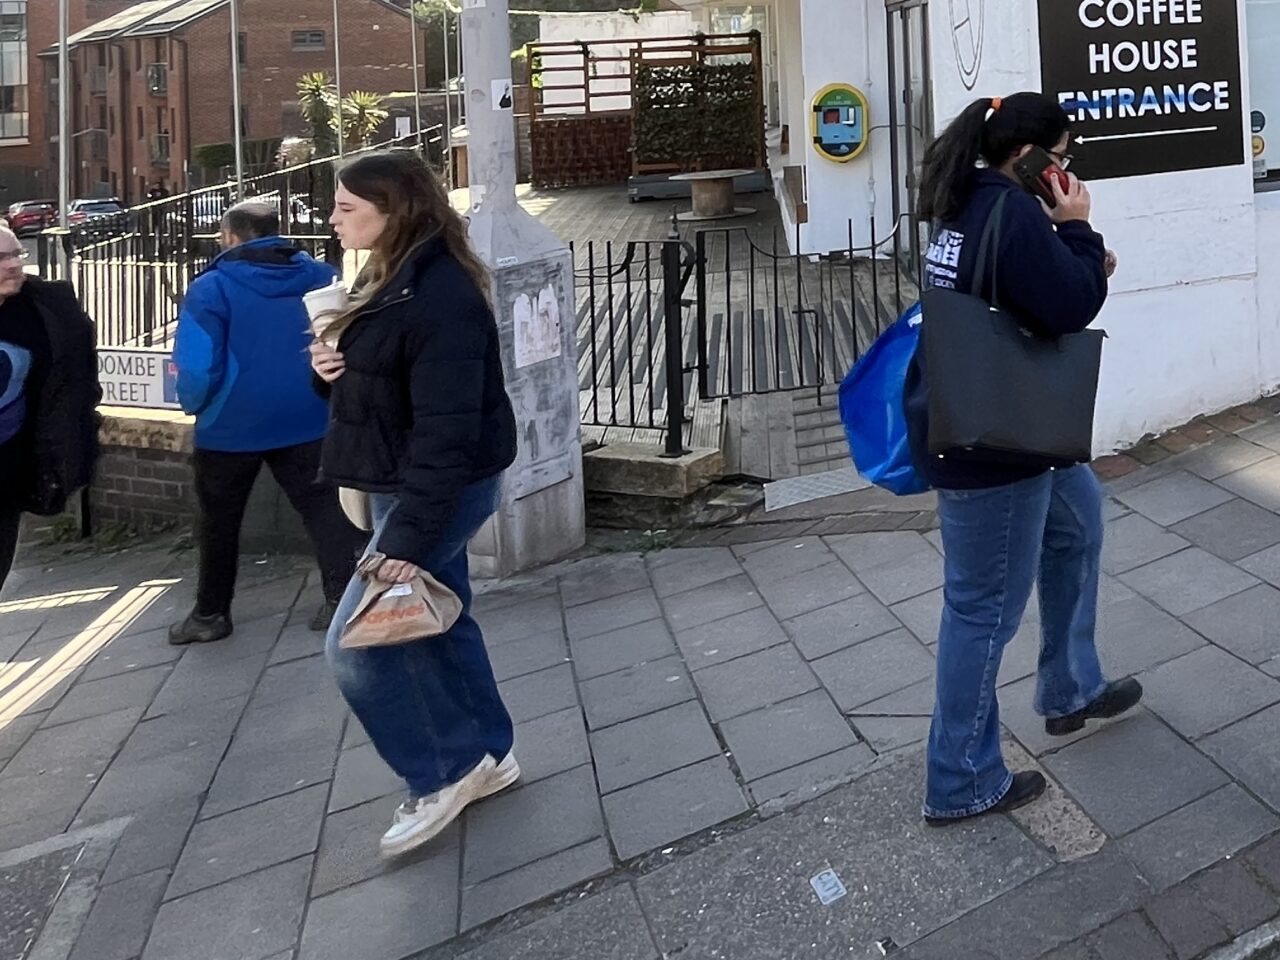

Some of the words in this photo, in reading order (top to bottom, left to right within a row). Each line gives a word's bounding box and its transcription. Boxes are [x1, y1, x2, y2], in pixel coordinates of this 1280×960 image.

[1088, 38, 1198, 74] HOUSE
[1057, 80, 1230, 122] ENTRANCE
[97, 355, 156, 377] OOMBE
[100, 382, 150, 402] REET
